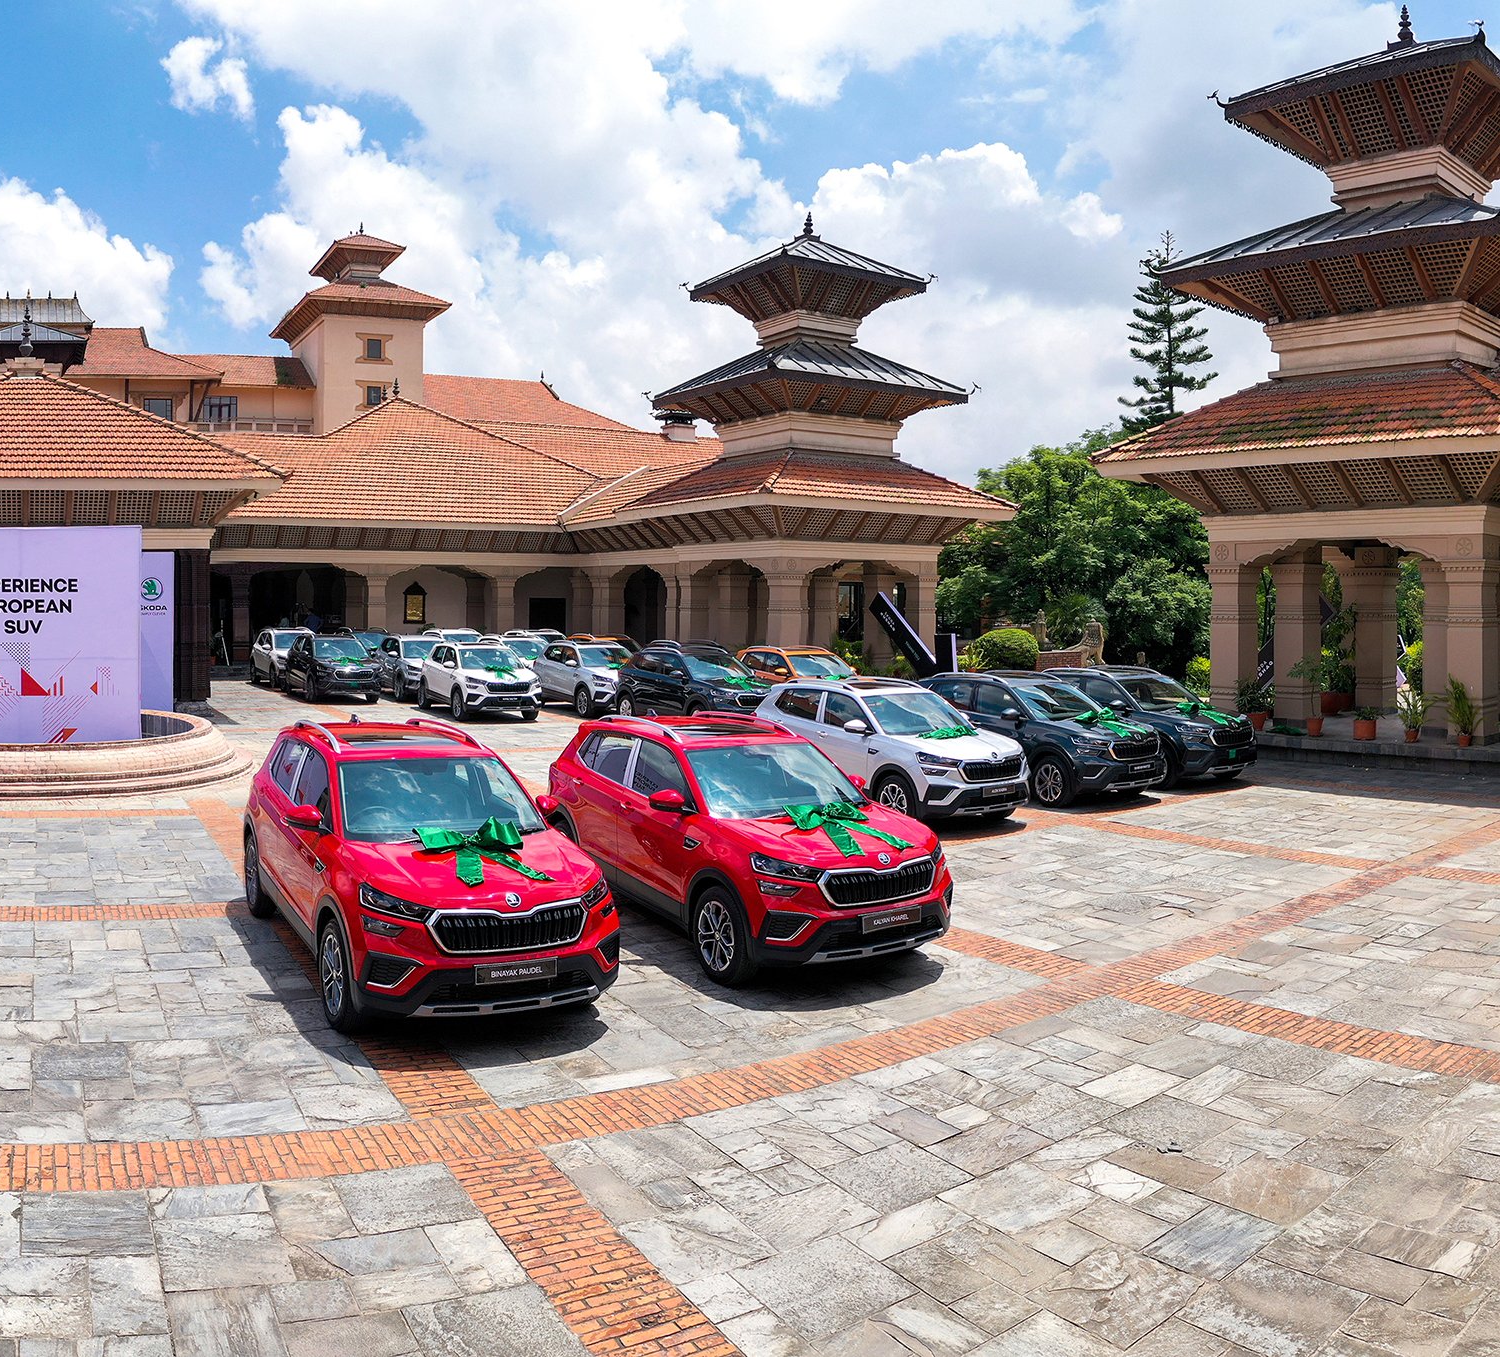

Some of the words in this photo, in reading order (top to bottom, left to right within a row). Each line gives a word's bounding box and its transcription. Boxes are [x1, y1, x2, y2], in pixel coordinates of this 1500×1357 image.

[4, 619, 44, 634] SUV
[490, 968, 518, 978] BINAYAK
[519, 966, 543, 976] PAUDEL
